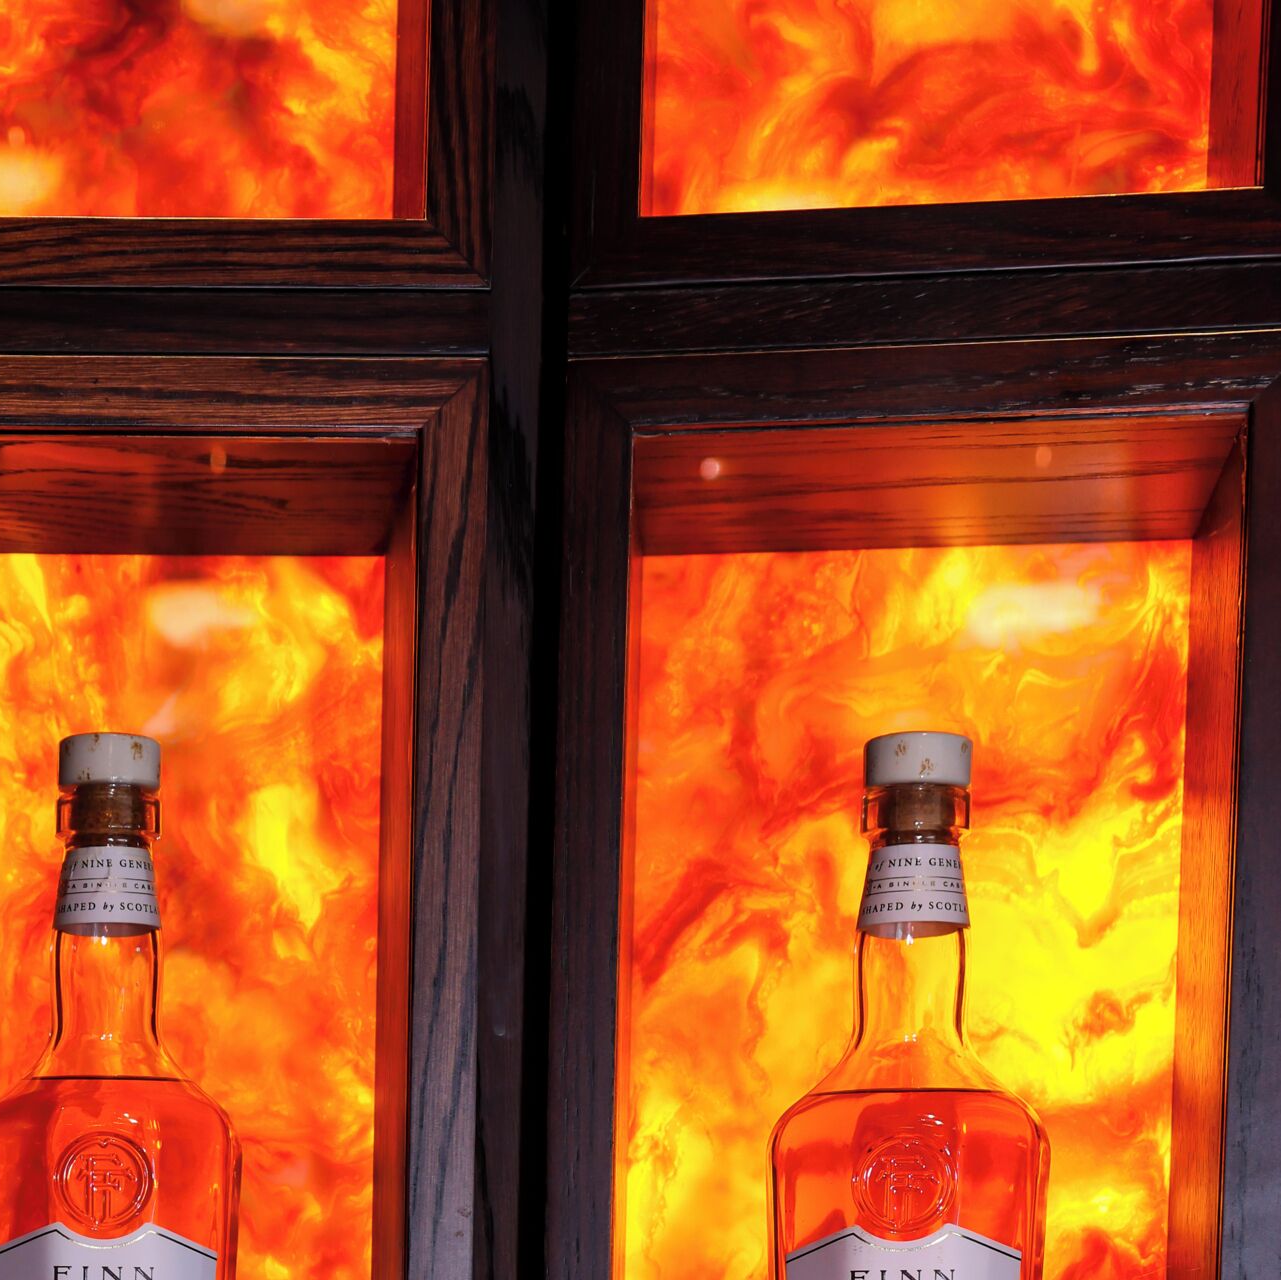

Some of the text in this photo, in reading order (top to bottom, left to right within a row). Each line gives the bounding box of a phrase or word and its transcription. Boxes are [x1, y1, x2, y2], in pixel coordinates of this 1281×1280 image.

[81, 858, 113, 869] NINE
[888, 857, 922, 868] NINE
[102, 901, 115, 912] by
[911, 901, 923, 911] by
